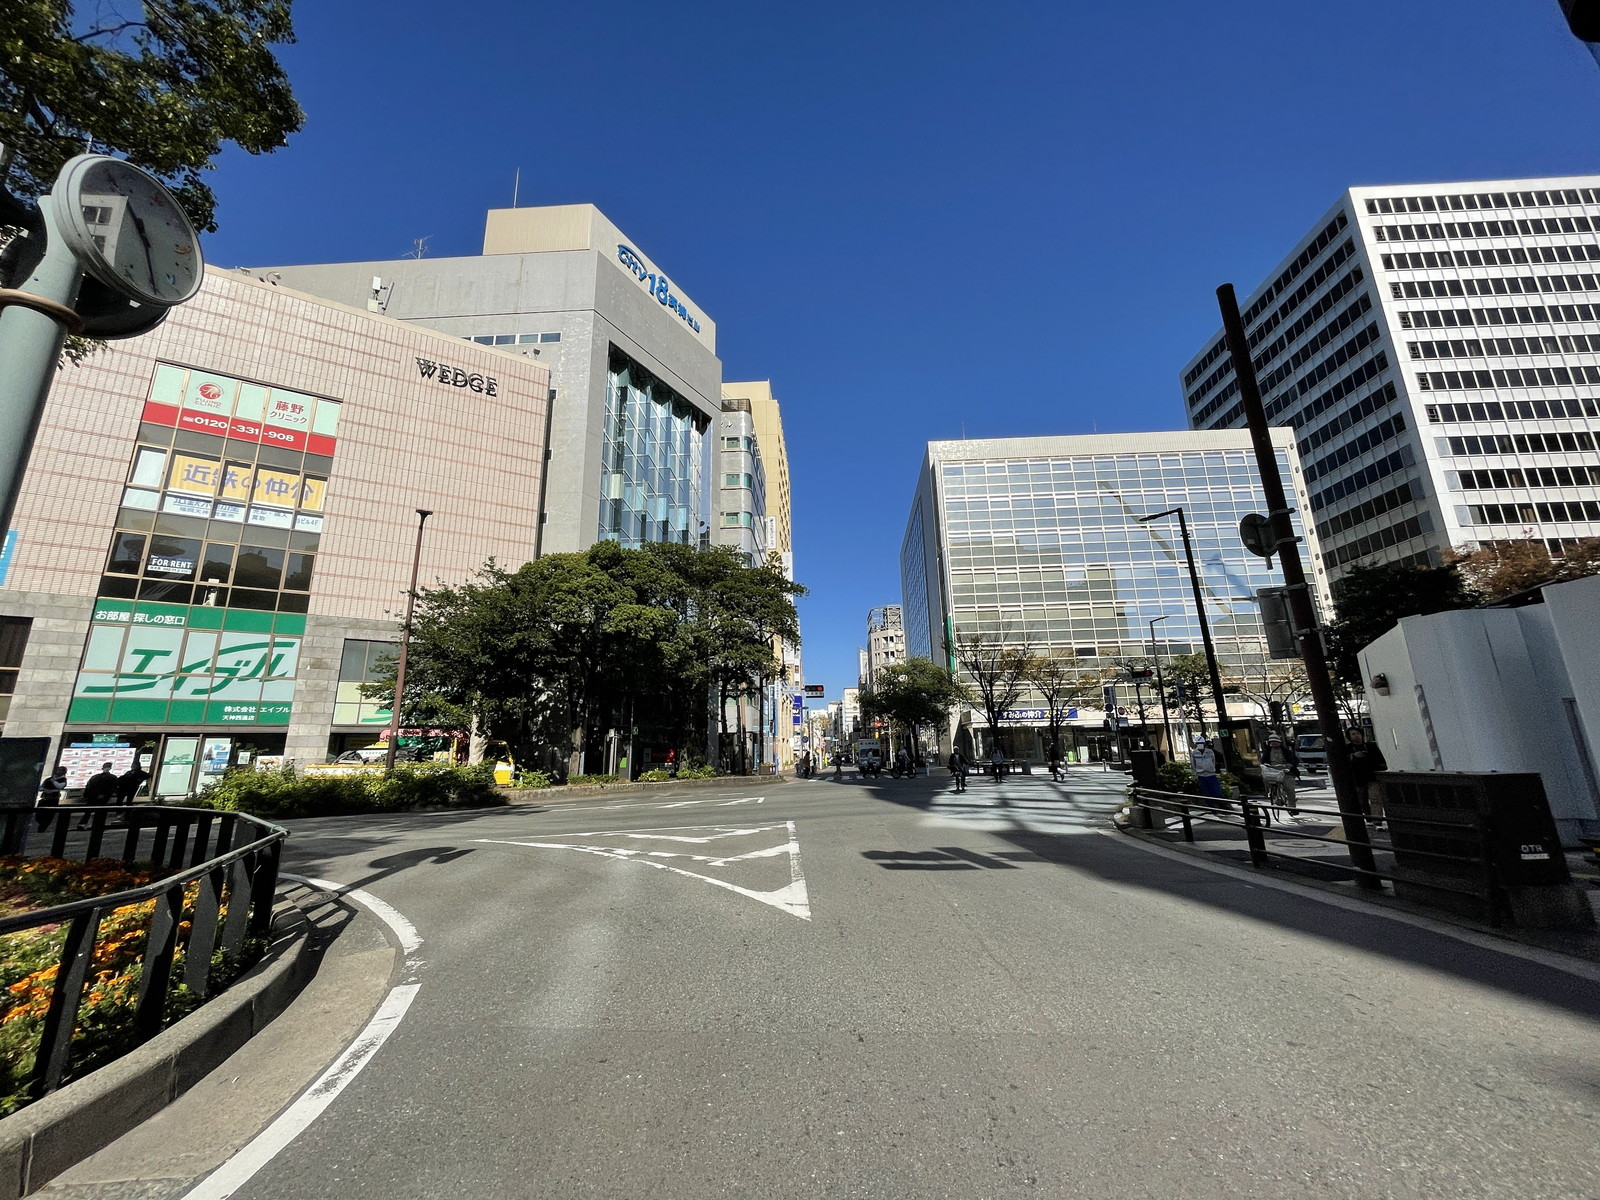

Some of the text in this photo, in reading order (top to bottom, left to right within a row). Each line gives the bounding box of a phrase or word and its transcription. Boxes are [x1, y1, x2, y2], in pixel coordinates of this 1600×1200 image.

[415, 357, 498, 397] WEDGE
[275, 401, 304, 414] 藤野
[269, 411, 307, 424] クリニック
[151, 558, 193, 569] FOR RENT
[82, 641, 296, 695] エイブル
